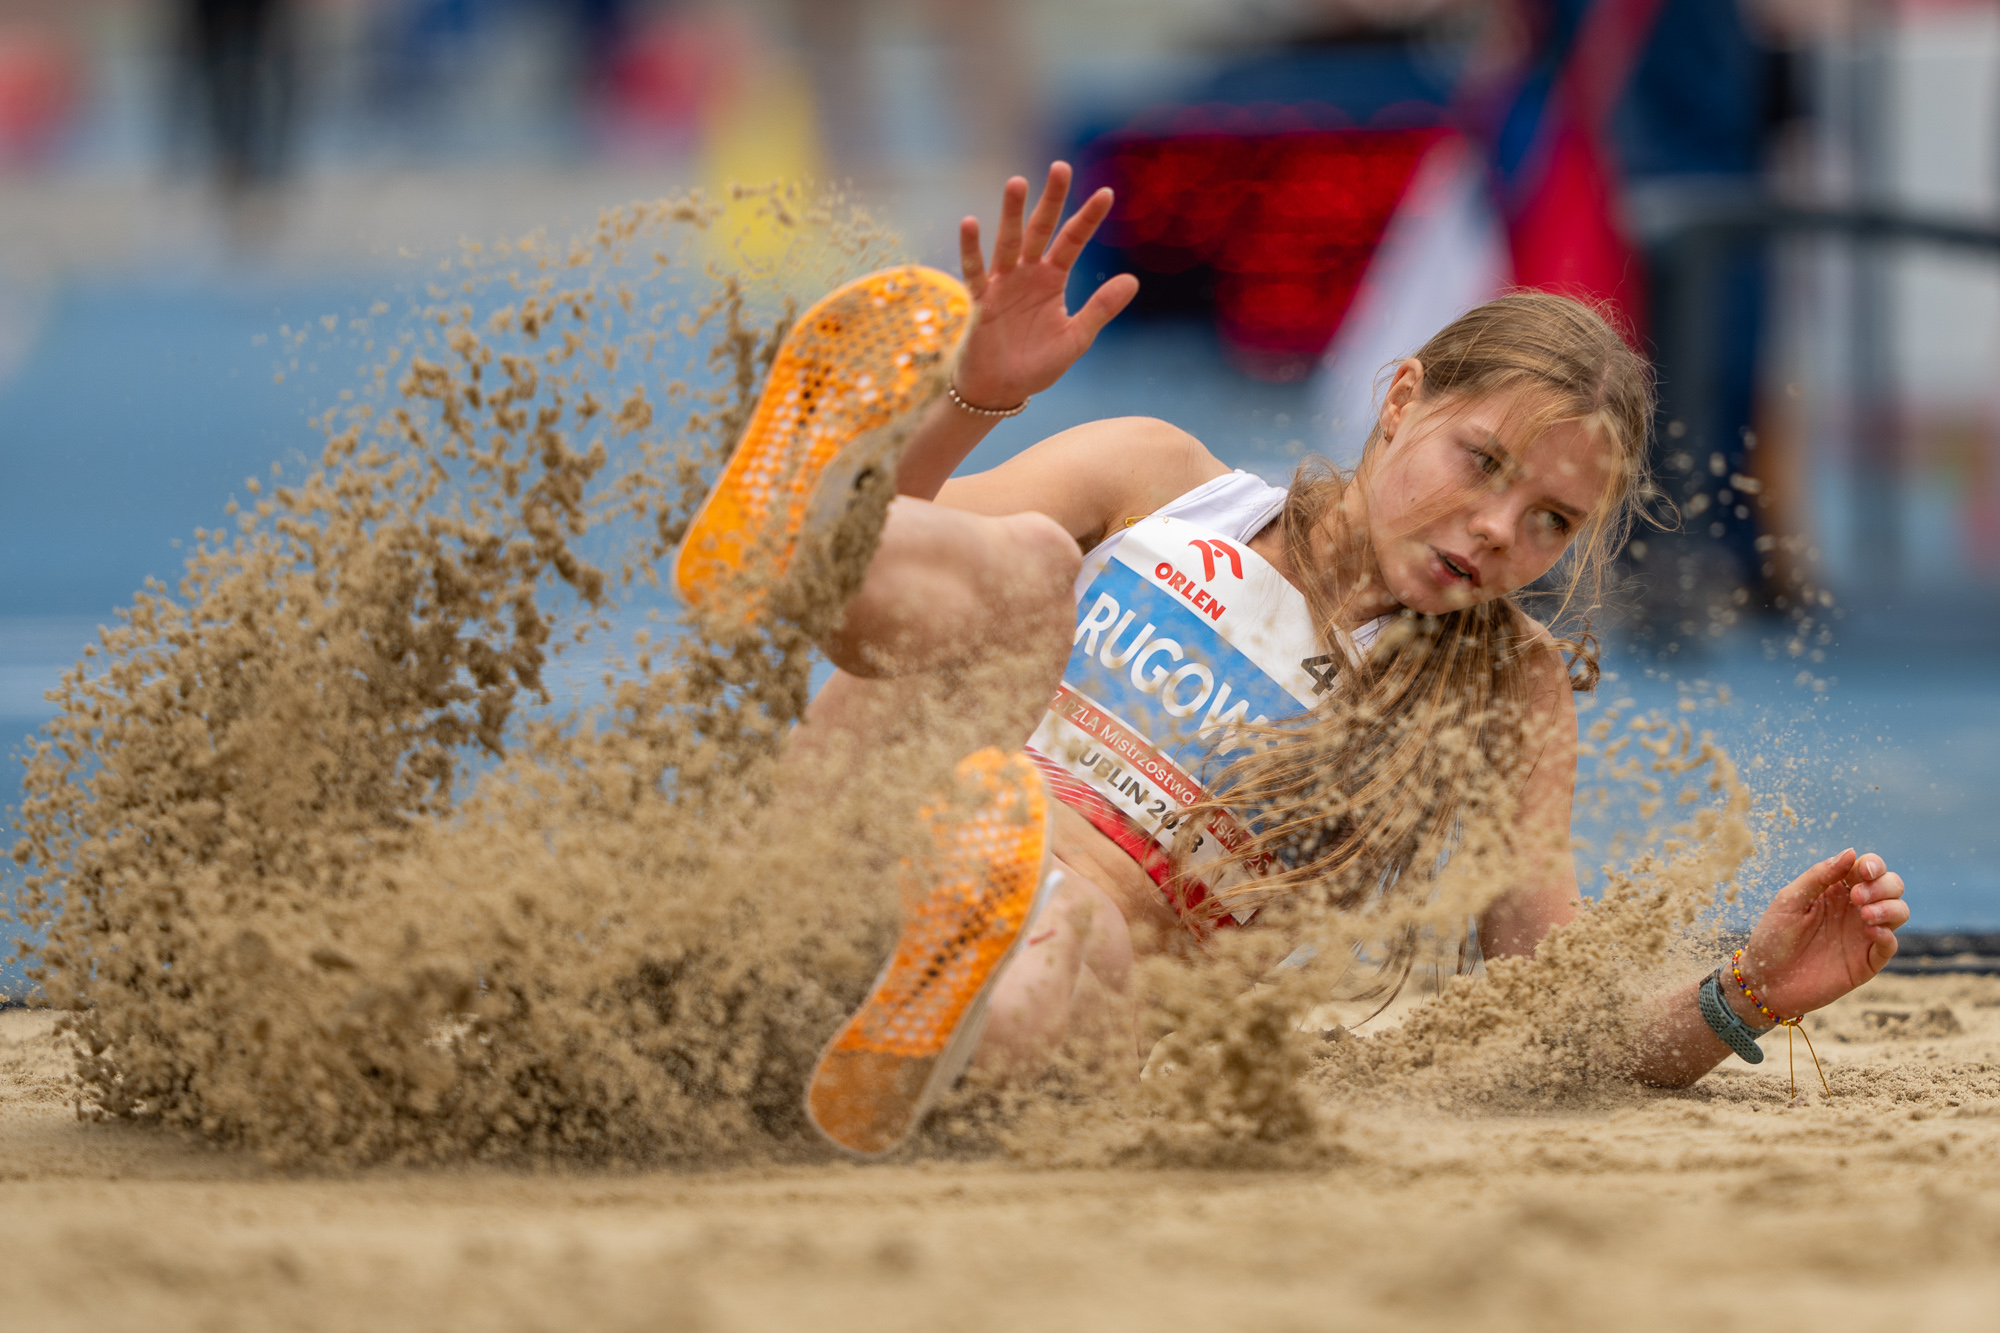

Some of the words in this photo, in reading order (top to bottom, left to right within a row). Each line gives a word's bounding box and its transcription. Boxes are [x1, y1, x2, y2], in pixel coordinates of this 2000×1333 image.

[1154, 562, 1227, 622] ORLEN
[1073, 592, 1278, 758] RUGOW
[1063, 699, 1100, 732] PZLA
[1100, 724, 1196, 805] Mistrzostwa
[1076, 745, 1150, 806] UBLIN
